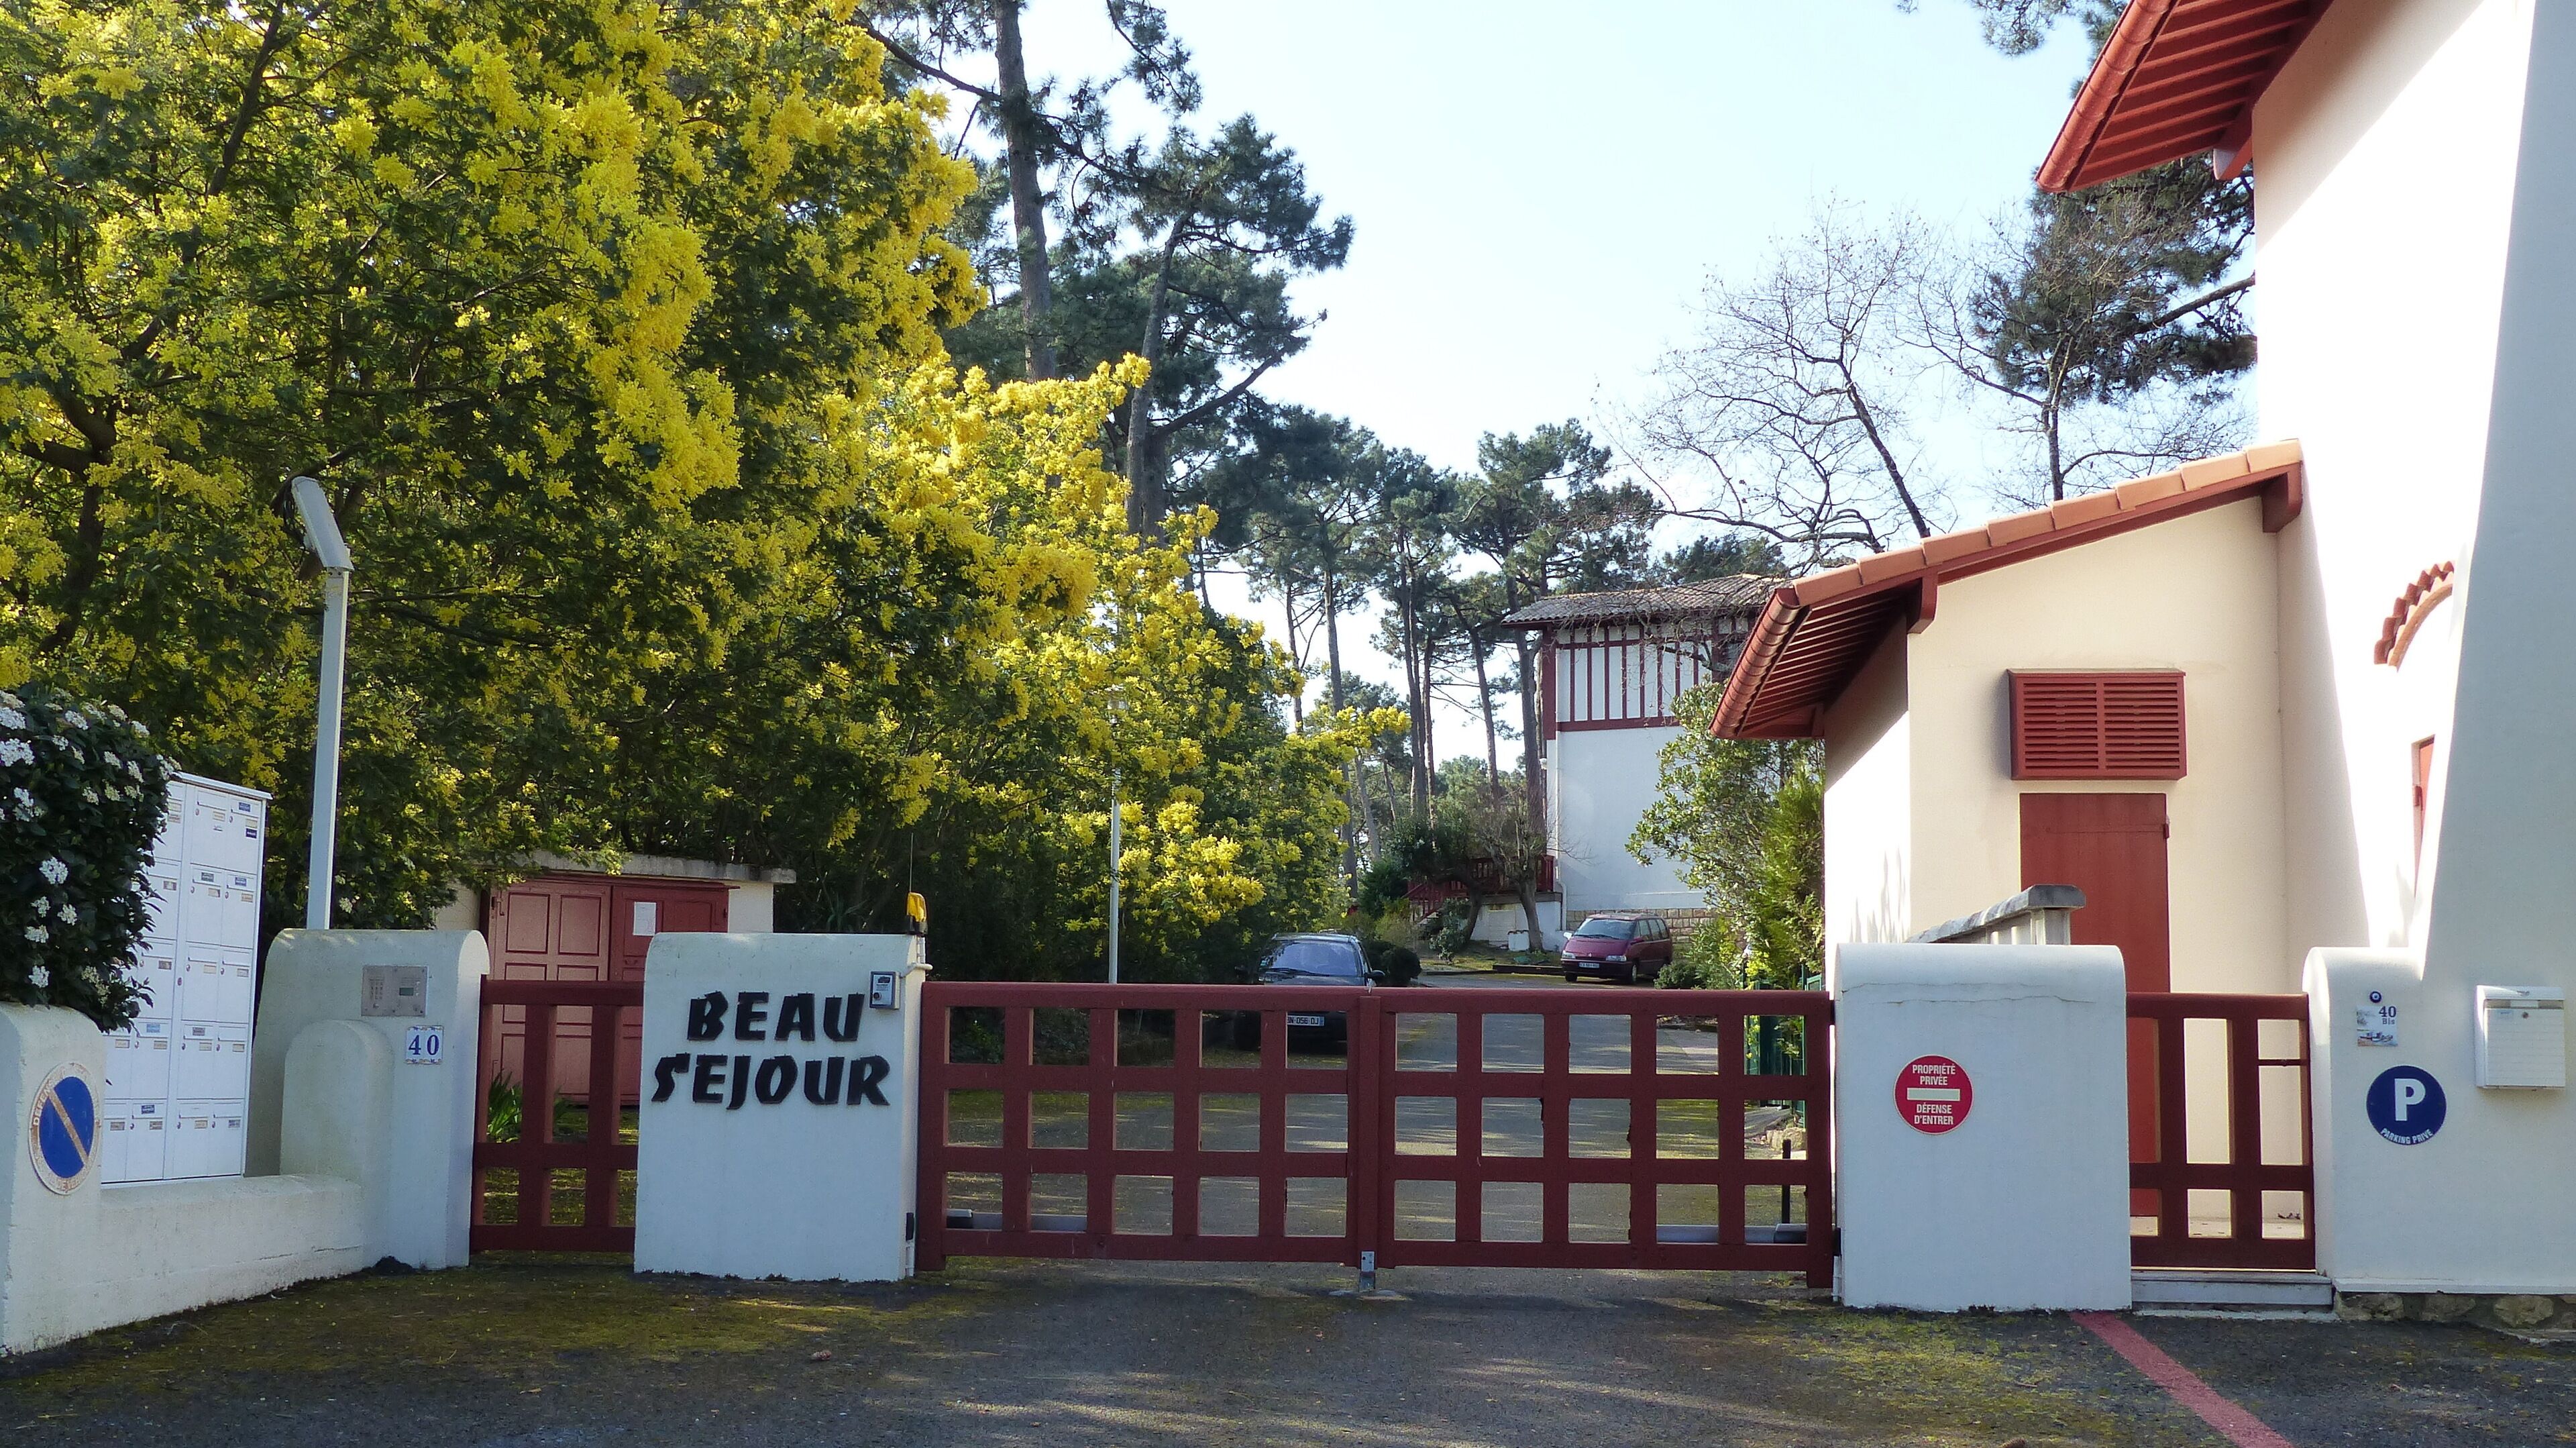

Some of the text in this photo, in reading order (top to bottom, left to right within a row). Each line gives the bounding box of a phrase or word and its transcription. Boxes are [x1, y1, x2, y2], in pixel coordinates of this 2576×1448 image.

[687, 990, 865, 1041] BEAU
[2379, 1006, 2396, 1017] 40
[408, 1034, 439, 1055] 40
[1913, 1064, 1955, 1074] PROPRIÉTÉ
[651, 1052, 891, 1110] SEJOUR
[1920, 1074, 1948, 1085] PRIVÉE
[2394, 1078, 2426, 1121] P
[1917, 1102, 1952, 1114] DÉFENSE
[1914, 1115, 1954, 1125] D'ENTRER
[2381, 1128, 2410, 1144] PARKING
